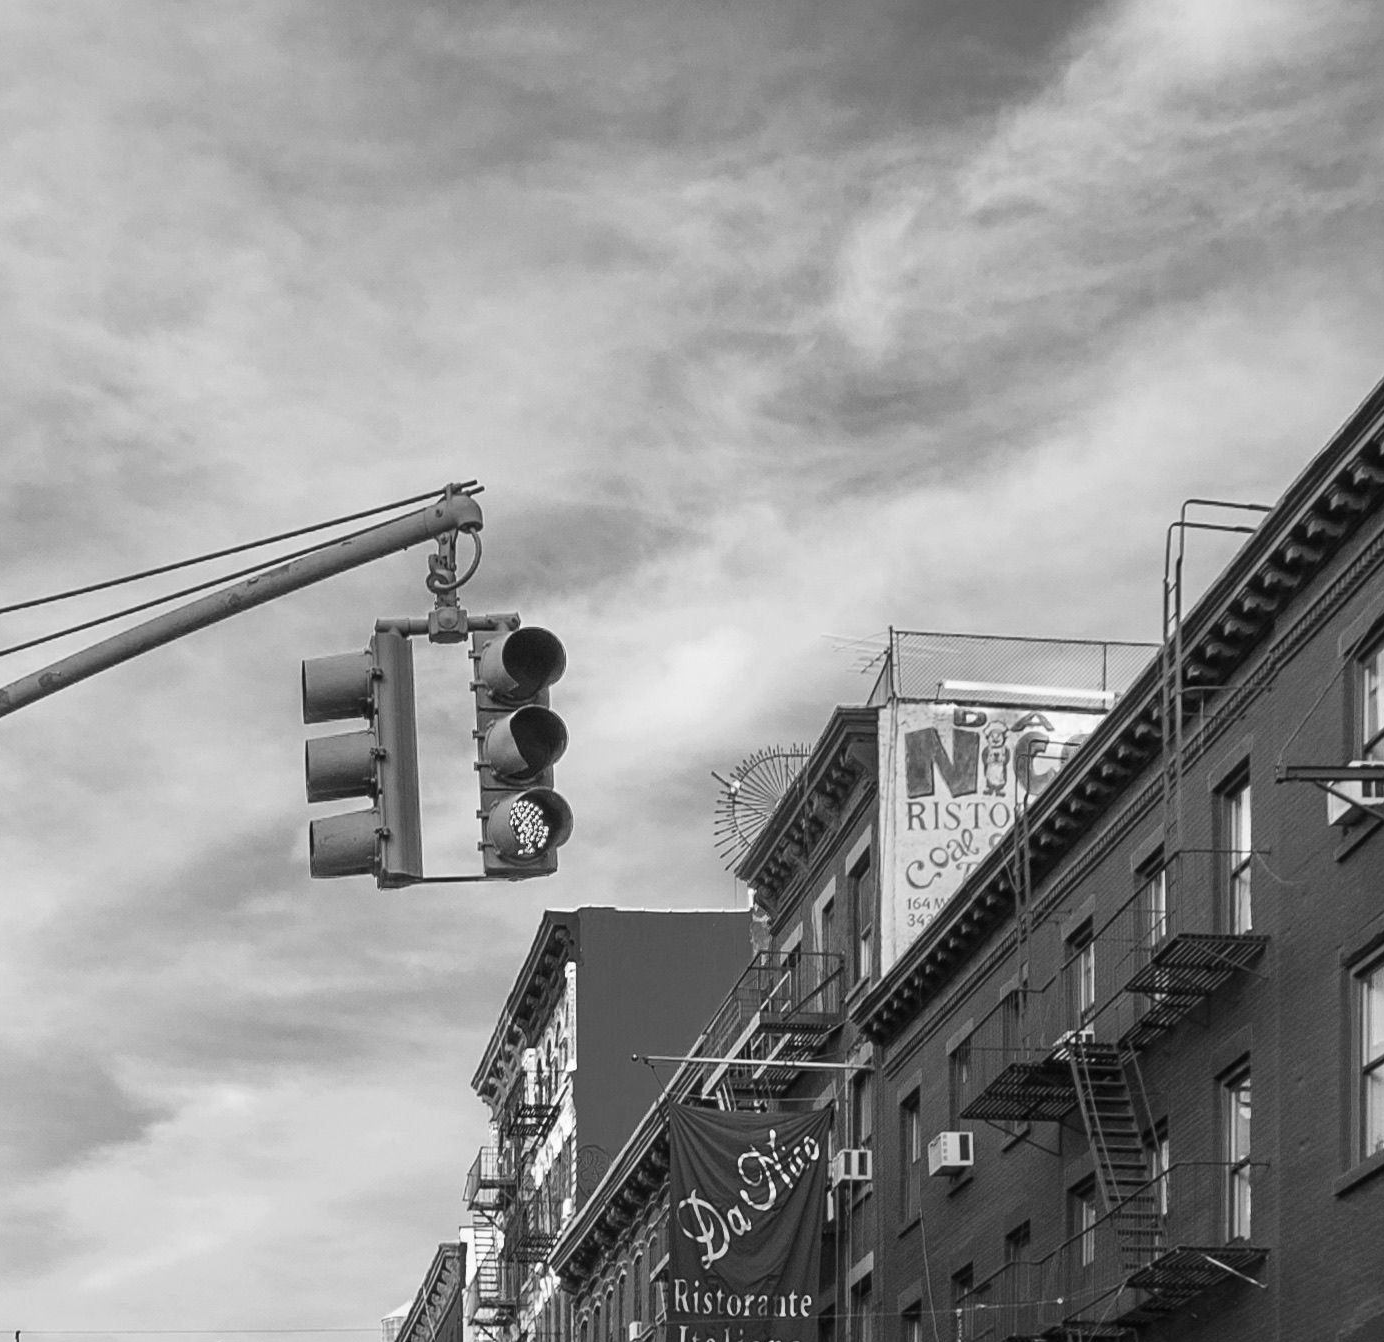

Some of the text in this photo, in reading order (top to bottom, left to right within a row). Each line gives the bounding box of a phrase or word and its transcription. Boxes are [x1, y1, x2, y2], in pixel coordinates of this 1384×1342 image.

[953, 708, 1055, 732] DA
[906, 801, 1011, 831] RISTO
[905, 828, 979, 890] Coal
[676, 1129, 820, 1271] Da Nico
[674, 1278, 813, 1320] Ristorante
